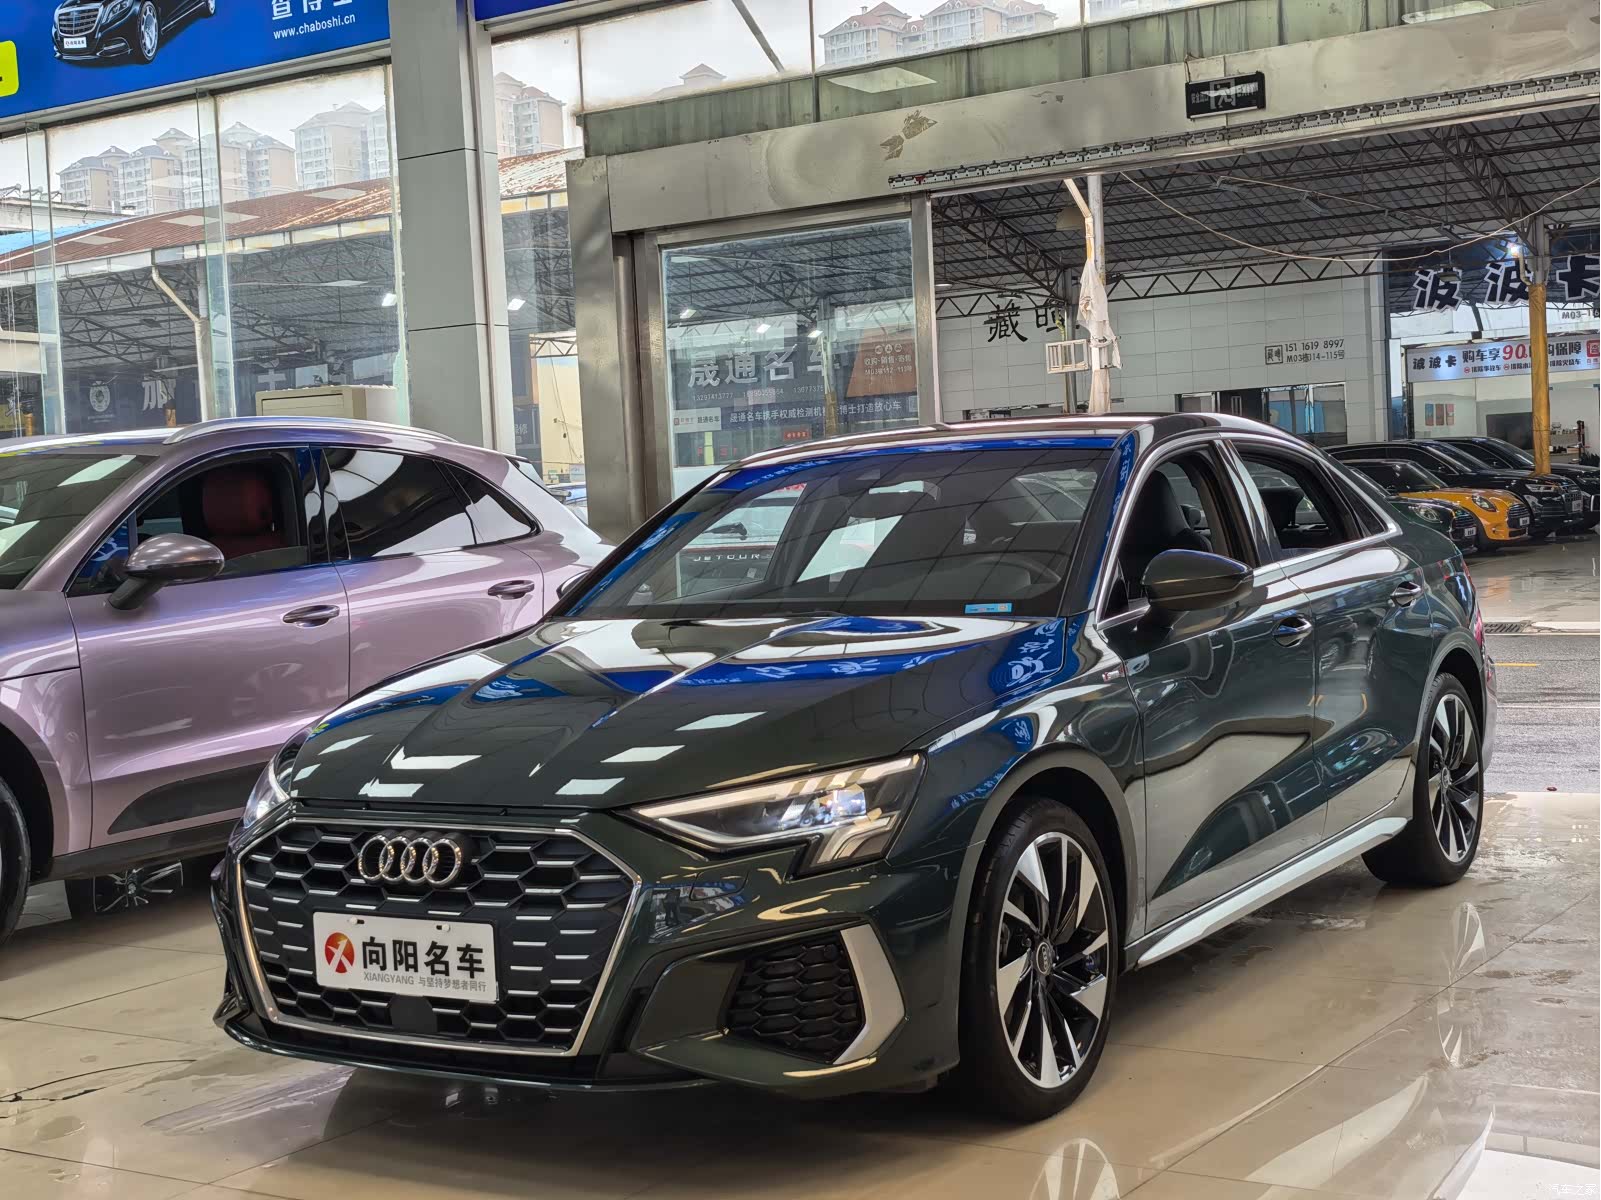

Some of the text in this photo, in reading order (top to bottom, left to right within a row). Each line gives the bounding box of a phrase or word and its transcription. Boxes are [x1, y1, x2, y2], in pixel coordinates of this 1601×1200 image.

[273, 14, 356, 39] www.chaboshi.cn
[1285, 339, 1345, 352] 151 1619 8997
[688, 344, 841, 388] 晟通名车
[693, 553, 760, 562] JETOUR
[362, 936, 485, 978] 向阳名车
[363, 971, 487, 992] XIANGYANG 与坚持梦想者同行
